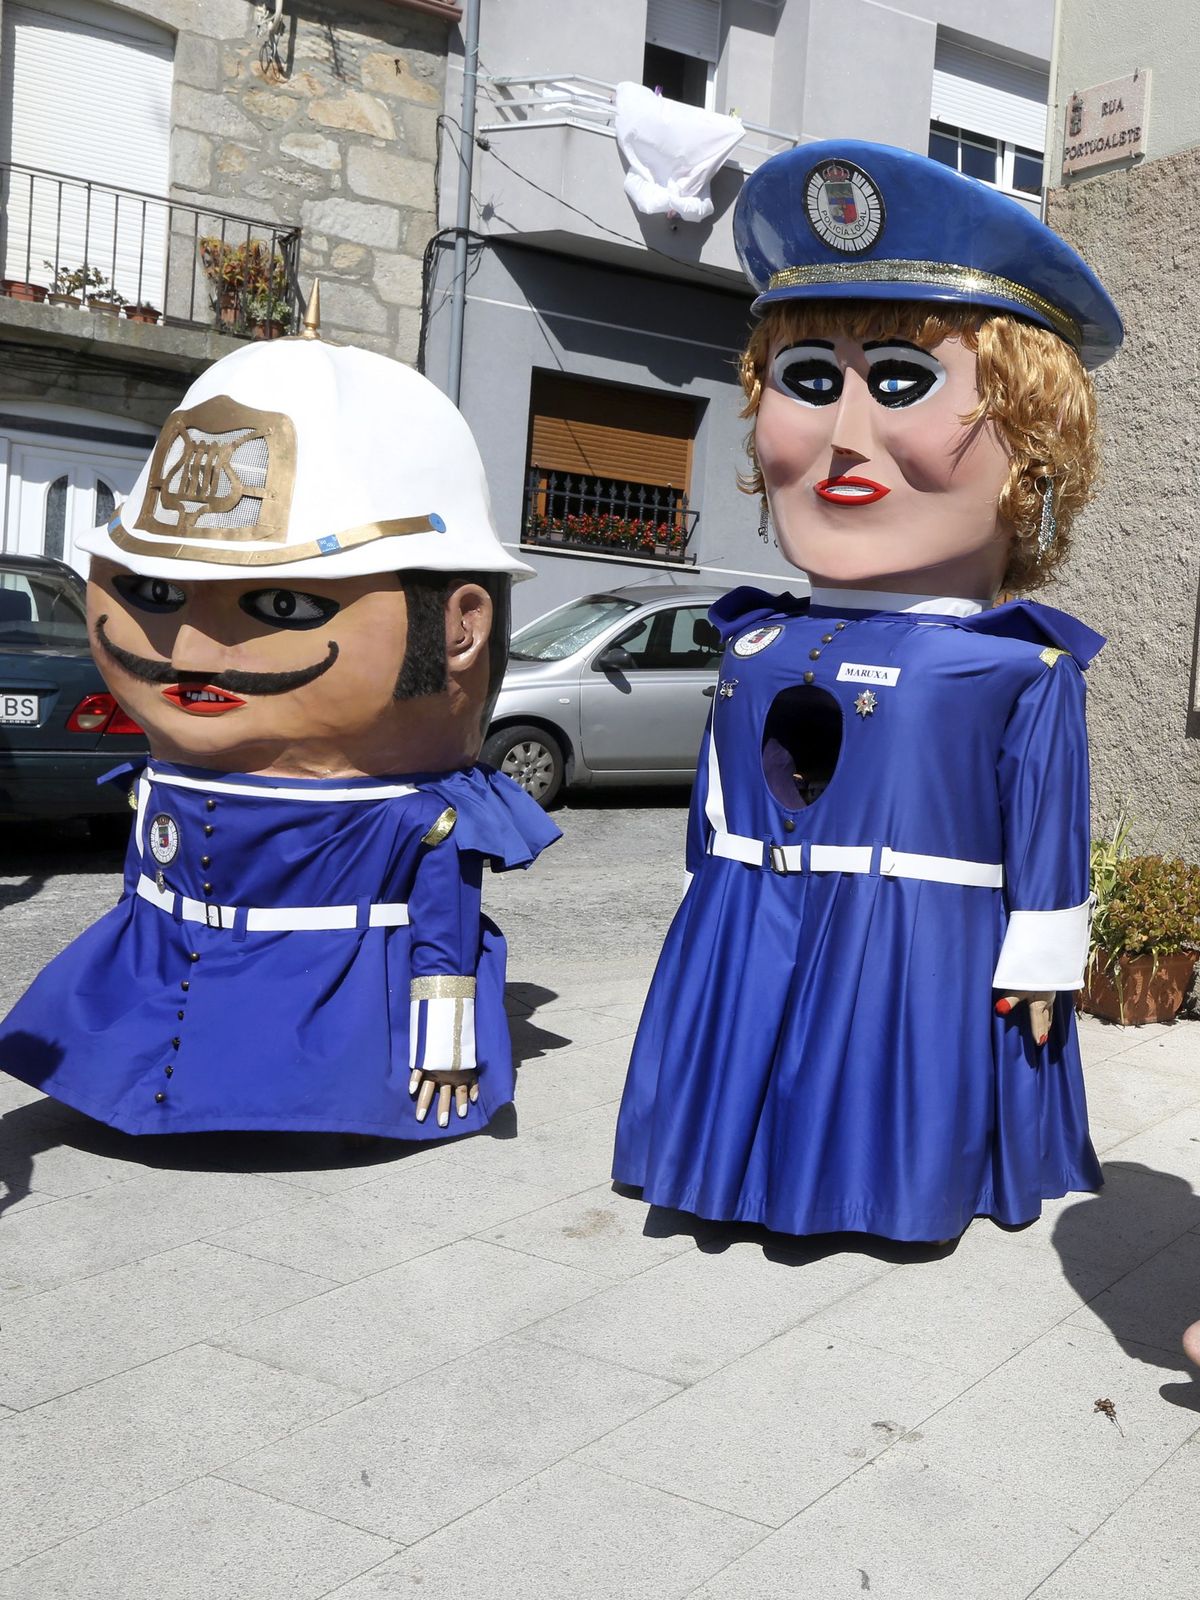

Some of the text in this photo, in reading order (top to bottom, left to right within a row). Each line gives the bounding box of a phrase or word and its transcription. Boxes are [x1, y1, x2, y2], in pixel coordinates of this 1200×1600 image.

[1101, 98, 1124, 118] RUA
[850, 210, 867, 235] LOCAL
[845, 668, 889, 680] MARUXA
[4, 697, 34, 717] BS
